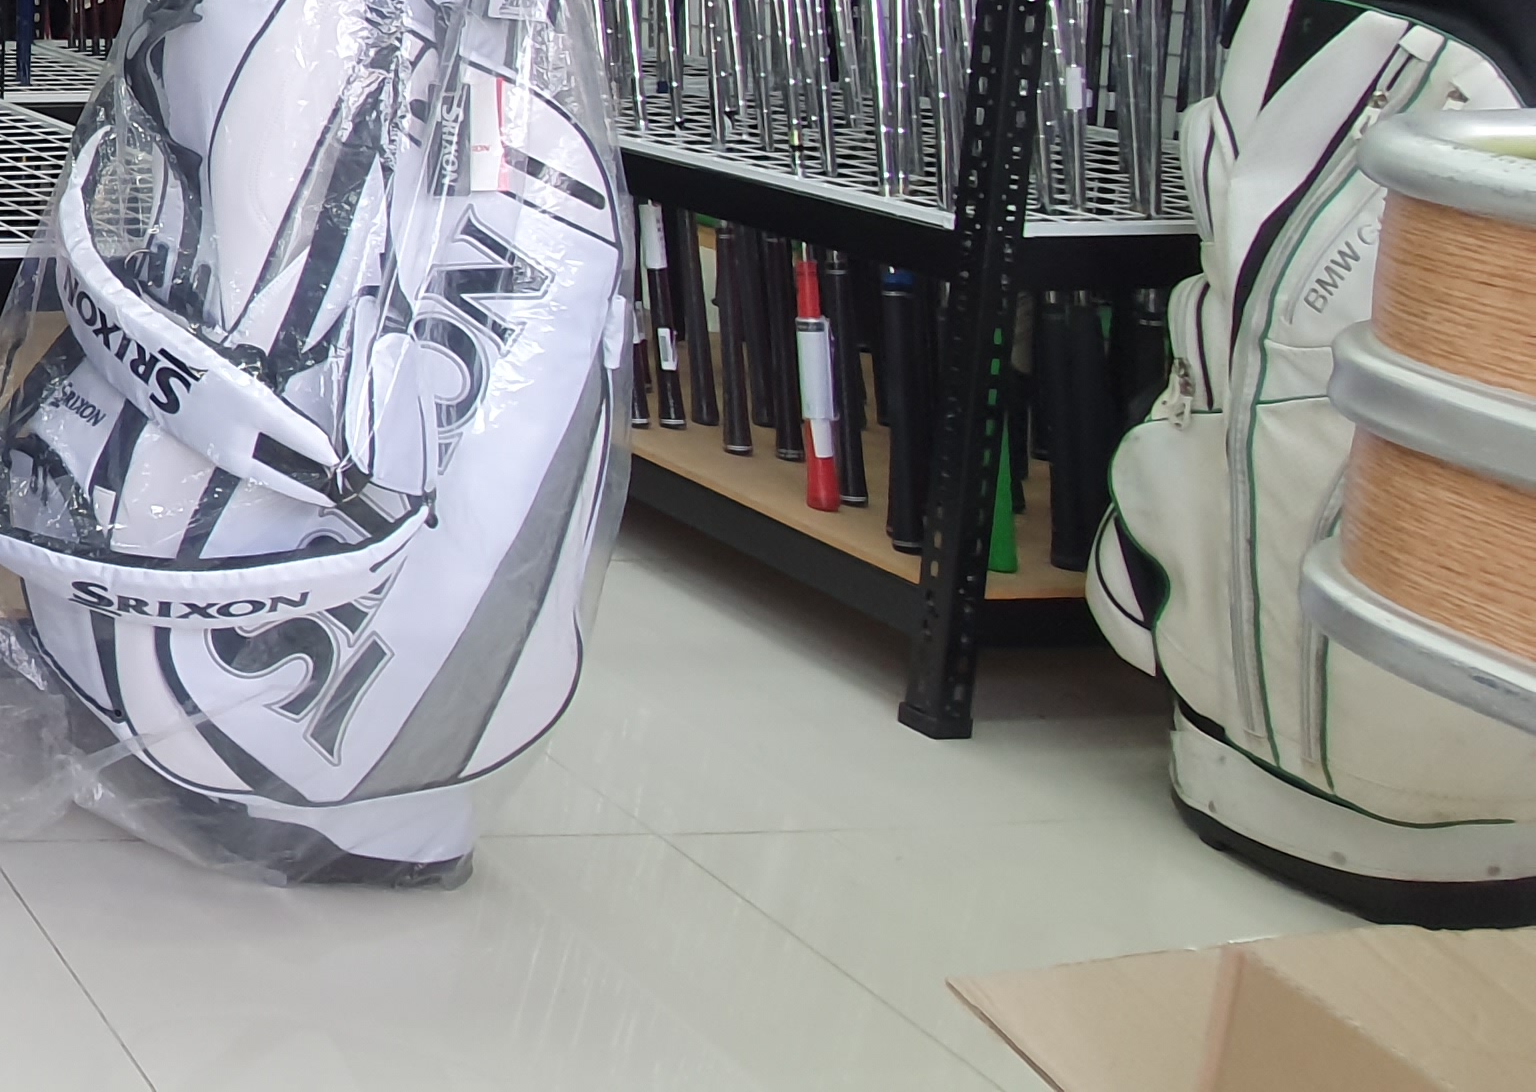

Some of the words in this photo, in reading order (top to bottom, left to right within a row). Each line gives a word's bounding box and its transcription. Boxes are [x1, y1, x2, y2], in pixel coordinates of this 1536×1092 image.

[1304, 242, 1361, 314] BMW
[64, 263, 209, 416] SRIXON
[58, 380, 107, 427] SRIXON
[68, 579, 311, 620] SRIXON
